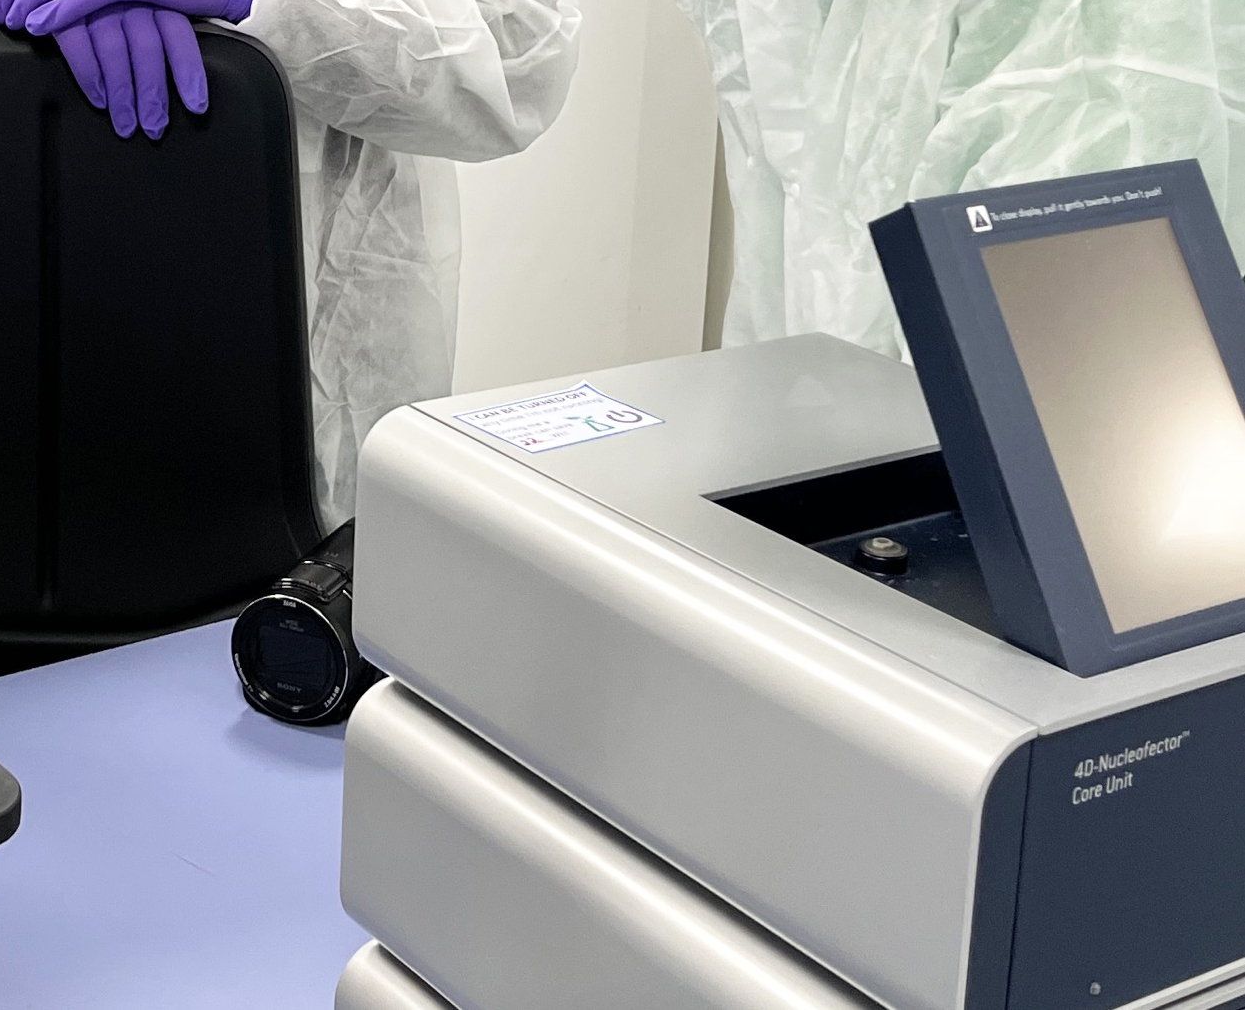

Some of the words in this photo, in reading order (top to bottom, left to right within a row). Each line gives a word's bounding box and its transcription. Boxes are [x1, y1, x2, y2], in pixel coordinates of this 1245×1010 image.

[474, 410, 500, 420] CAN
[503, 405, 519, 415] BE
[522, 395, 565, 410] TURNED
[566, 391, 587, 401] OFF
[1072, 783, 1103, 805] Core
[1106, 771, 1134, 794] Unit
